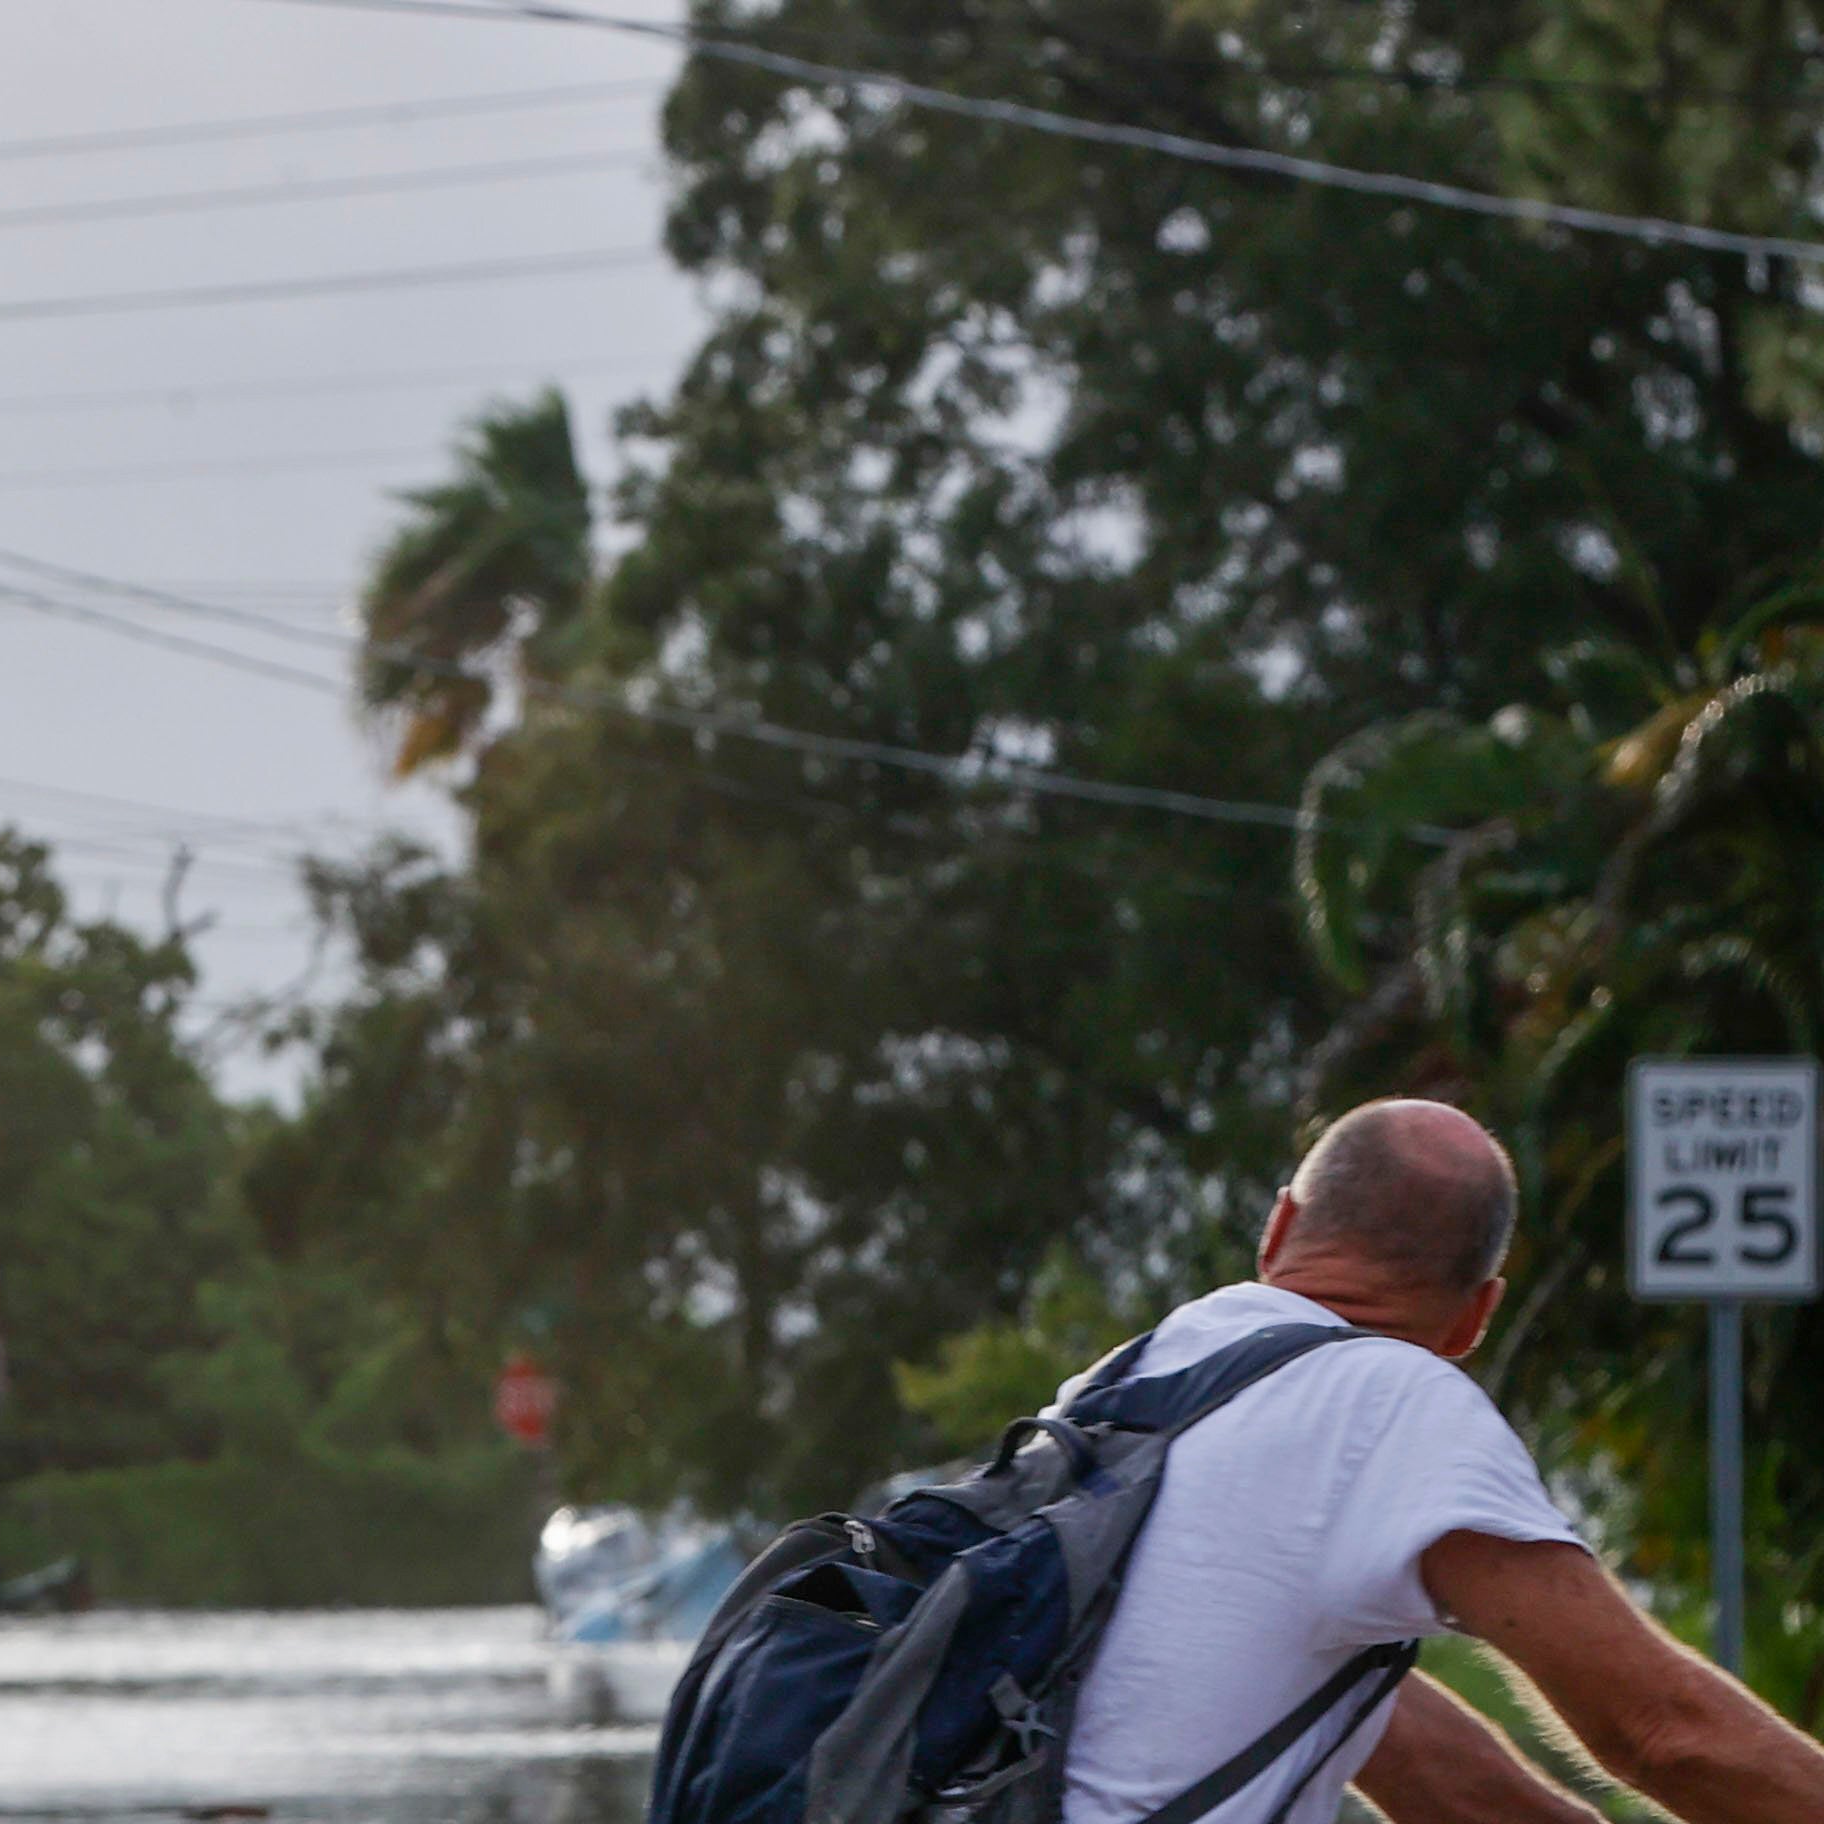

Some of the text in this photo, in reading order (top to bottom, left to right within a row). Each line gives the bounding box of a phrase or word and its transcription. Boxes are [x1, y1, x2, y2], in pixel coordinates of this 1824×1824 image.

[1651, 1087, 1803, 1128] SPEED
[1663, 1136, 1780, 1172] LIMIT
[1655, 1183, 1799, 1268] 25
